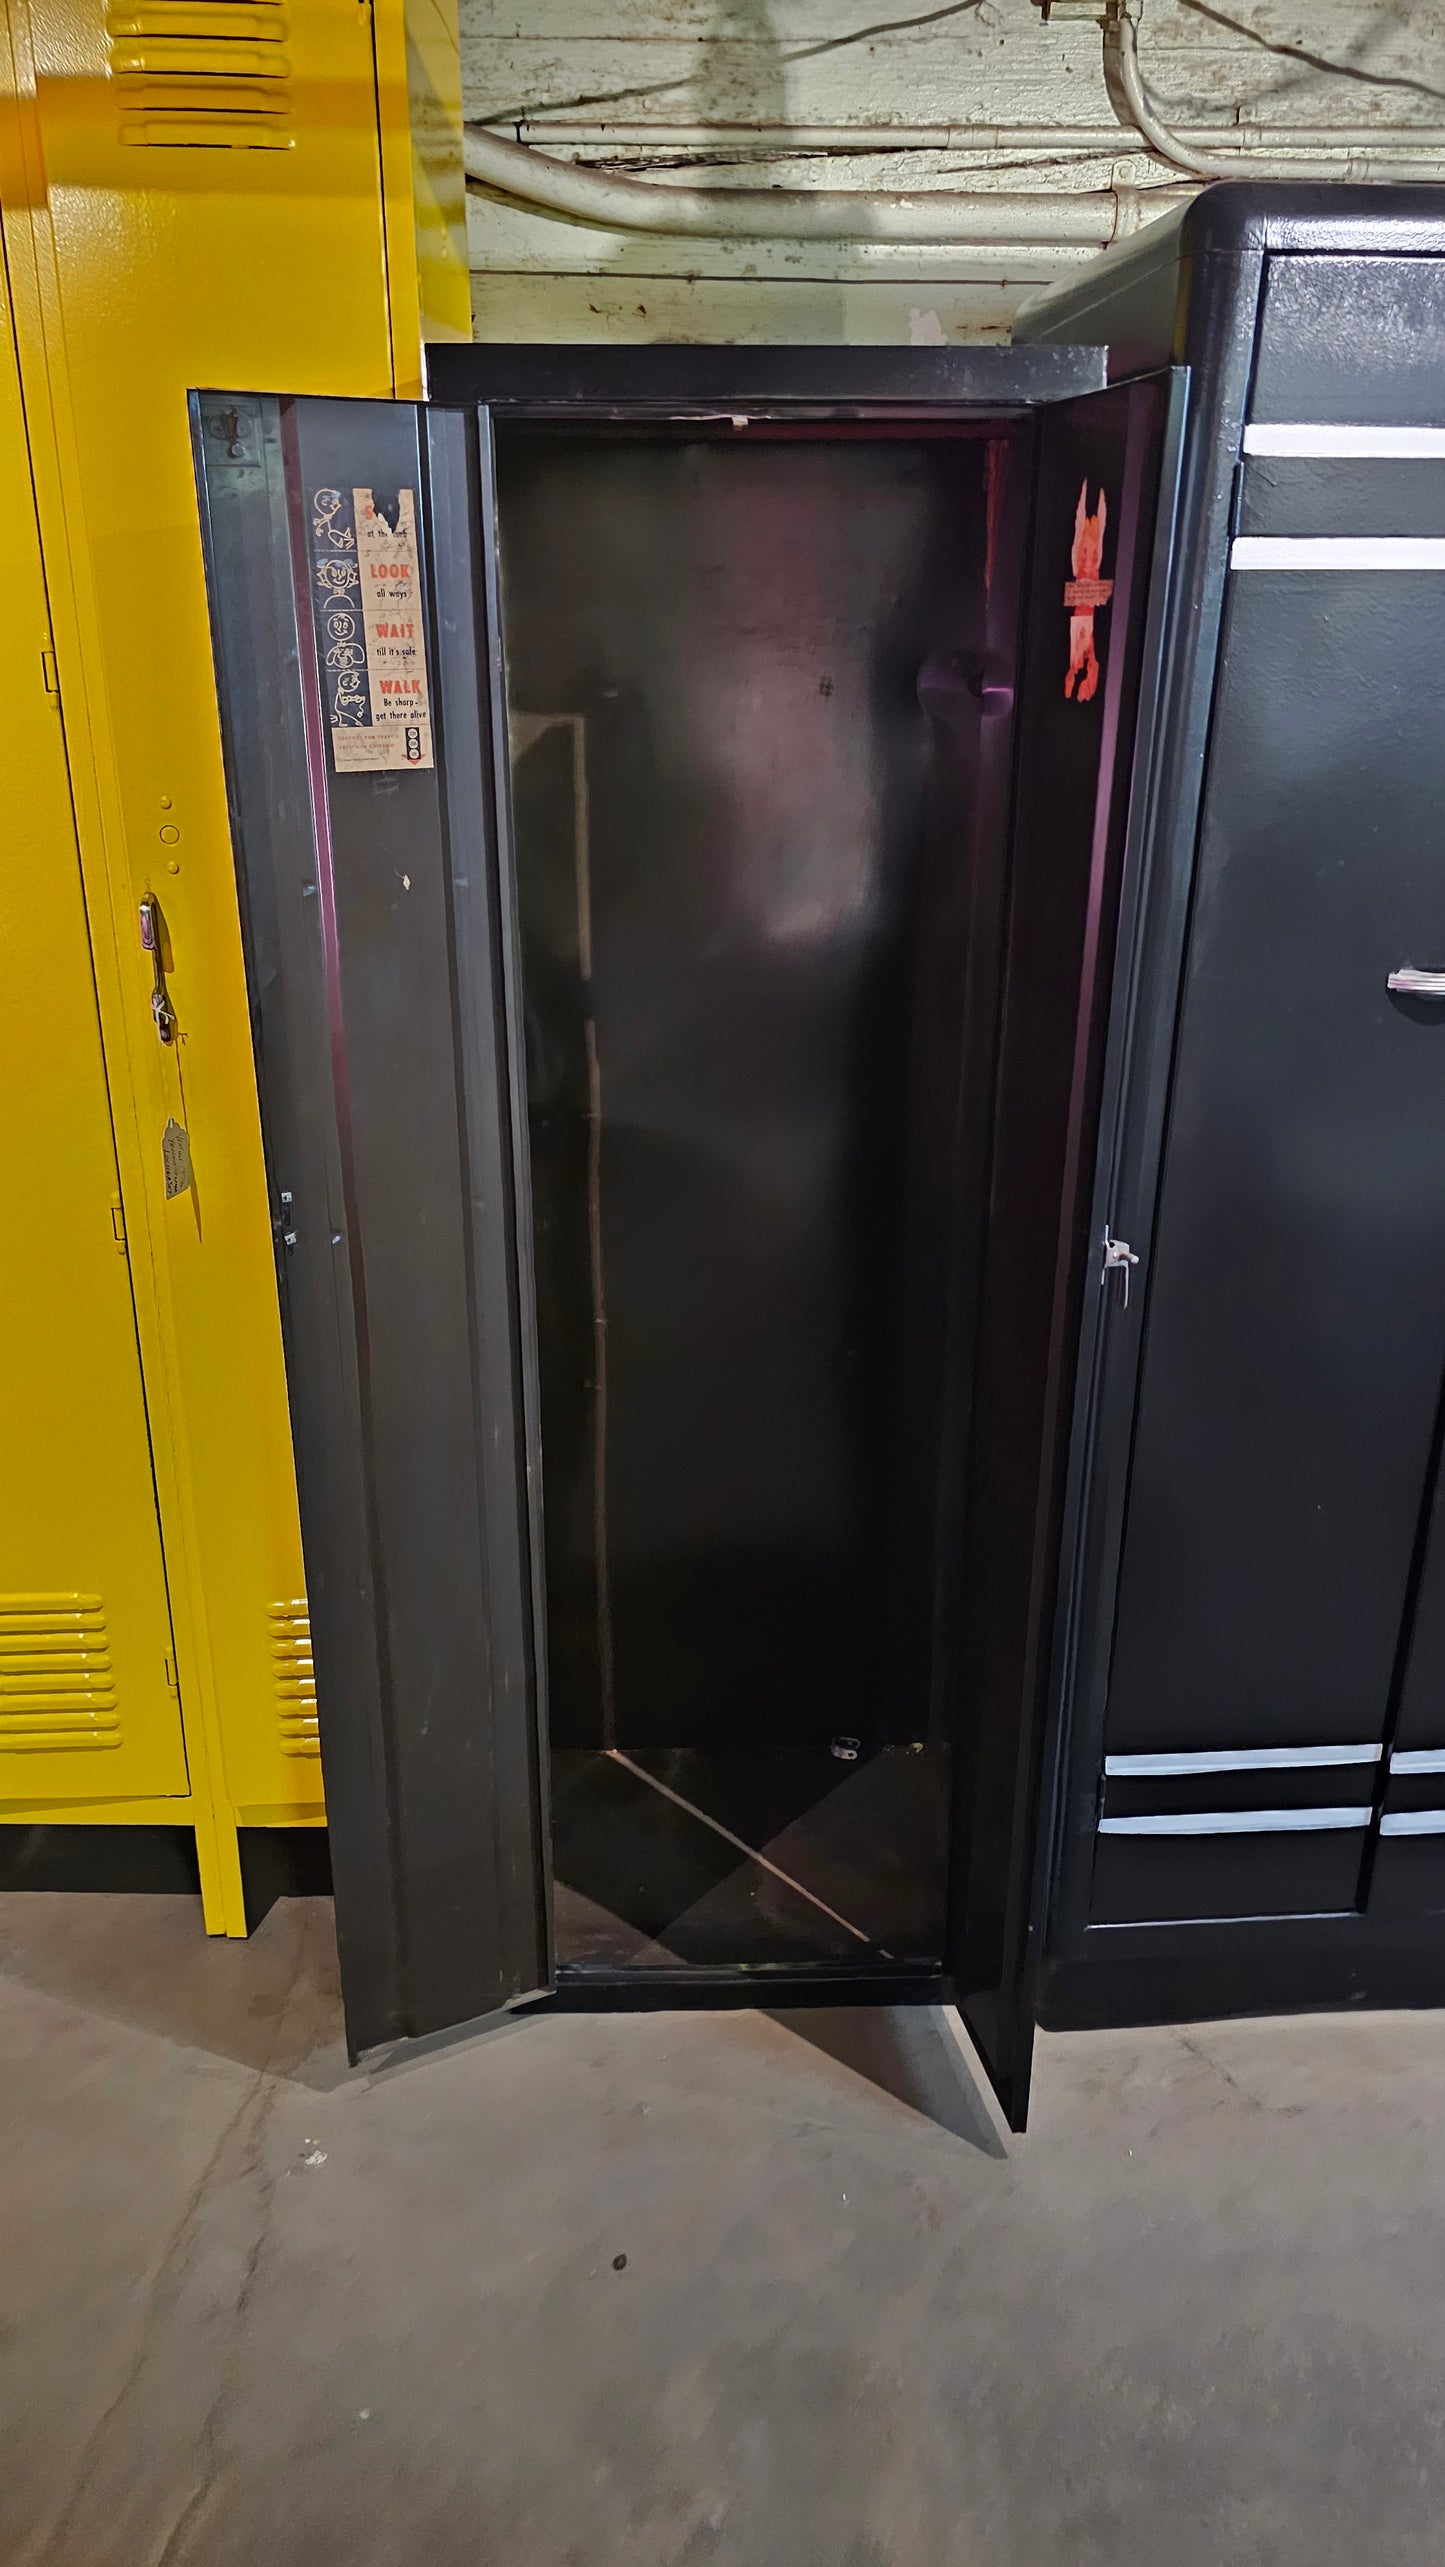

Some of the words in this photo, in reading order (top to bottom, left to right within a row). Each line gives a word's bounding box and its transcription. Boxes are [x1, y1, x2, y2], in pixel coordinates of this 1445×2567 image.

[370, 563, 410, 579] LOOK
[376, 588, 386, 598] all
[389, 591, 408, 599] ways
[376, 624, 414, 638] WAIT
[376, 646, 386, 656] till
[389, 646, 400, 656] it's
[402, 646, 416, 656] safe
[380, 680, 421, 694] WALK
[376, 712, 386, 720] get
[390, 711, 408, 719] there
[410, 710, 426, 718] alive
